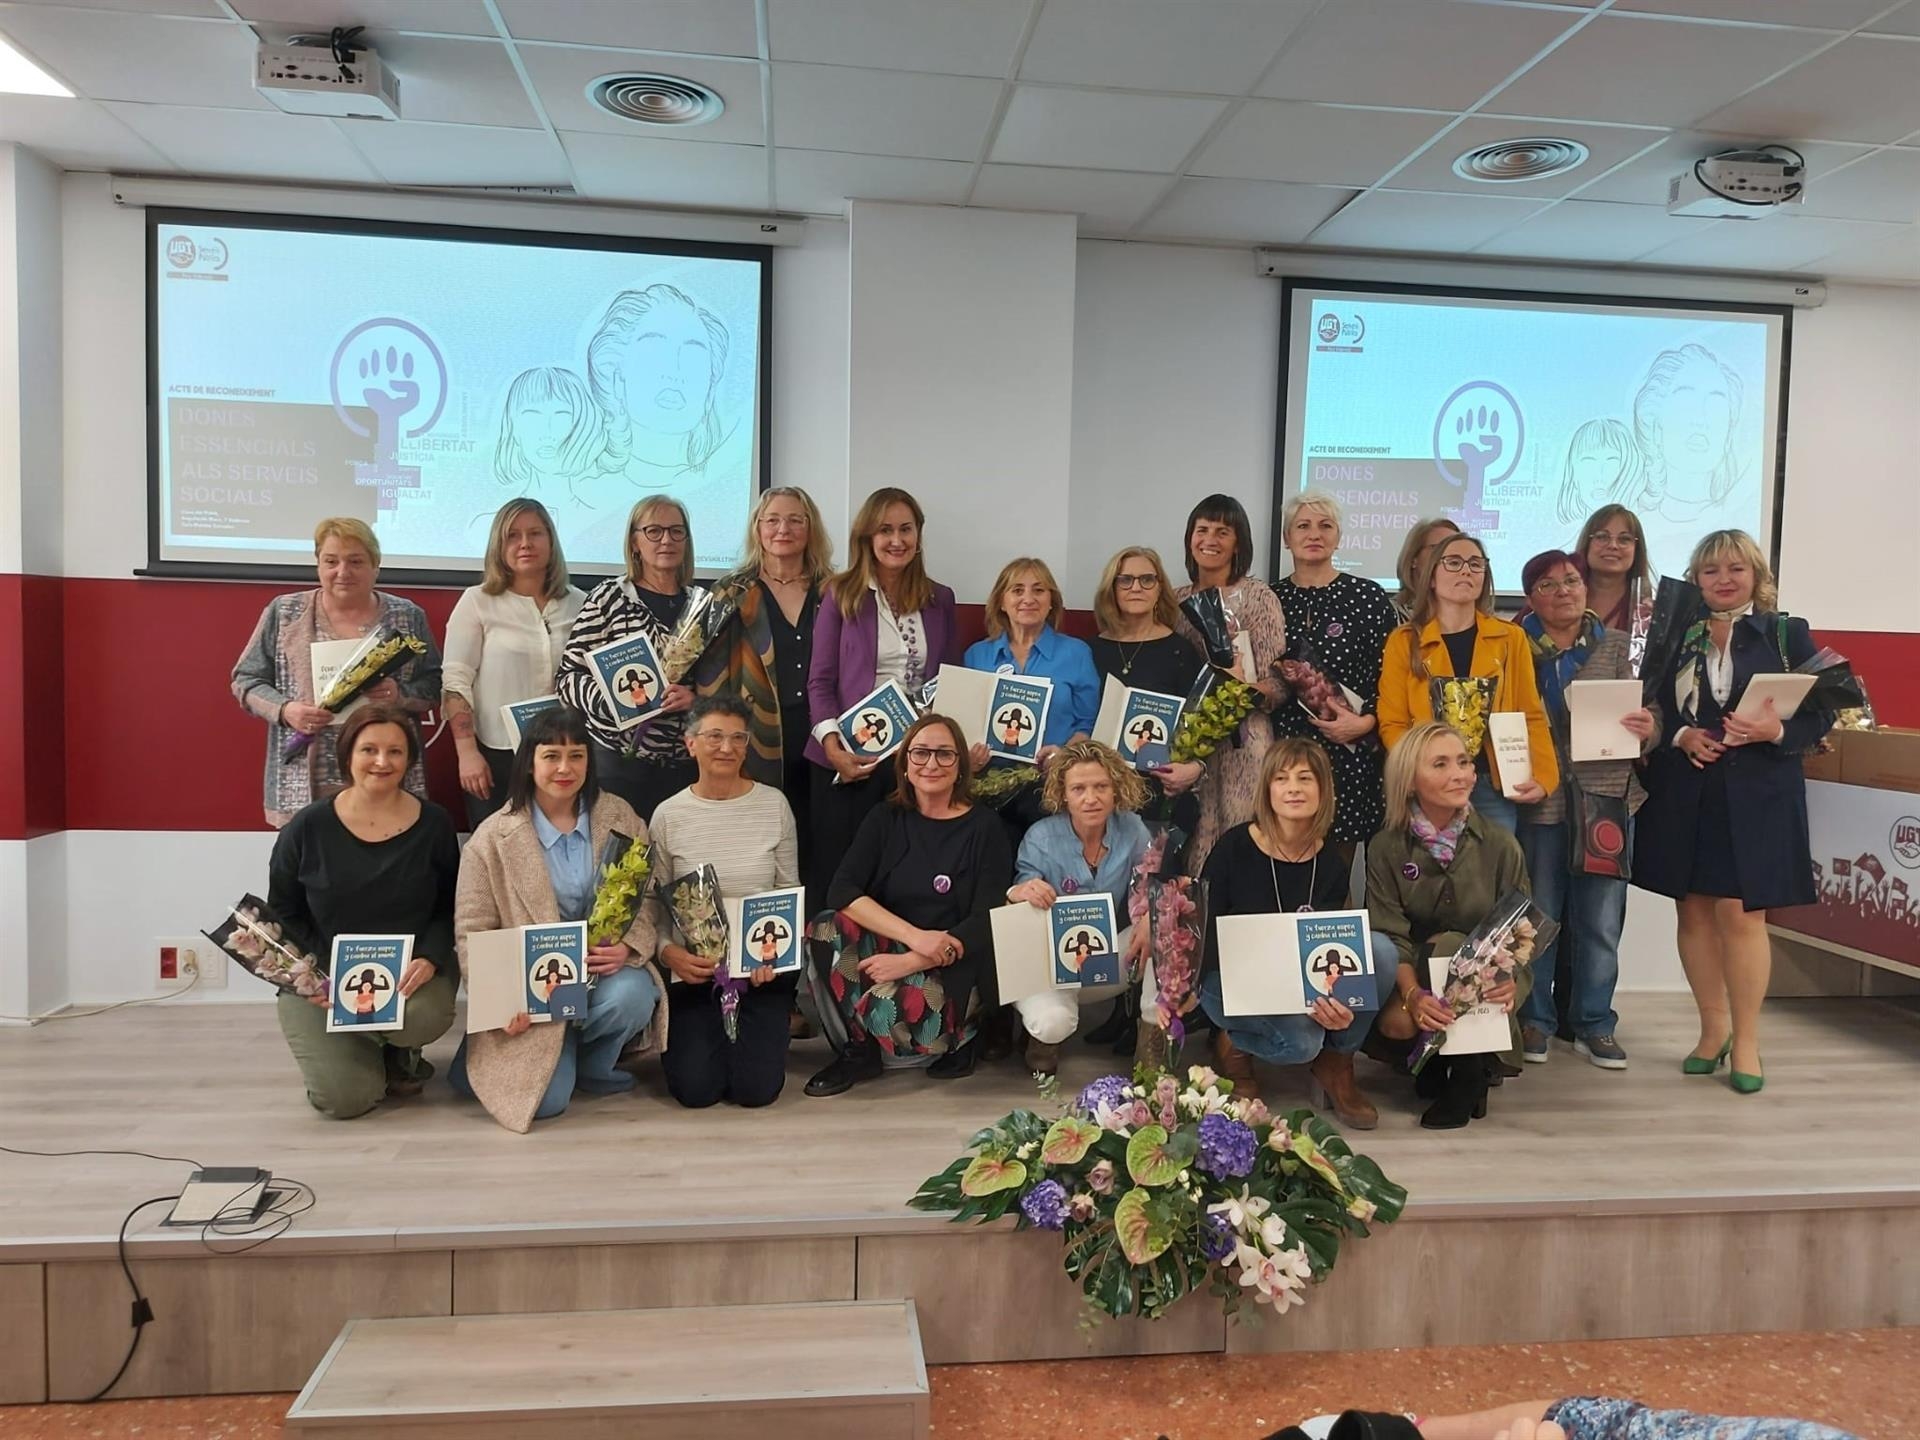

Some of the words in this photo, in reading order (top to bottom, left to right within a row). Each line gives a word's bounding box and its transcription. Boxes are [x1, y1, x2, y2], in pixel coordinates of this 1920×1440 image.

[169, 384, 191, 394] ACTE
[193, 385, 204, 395] DE
[206, 386, 276, 397] RECONEIXEMENT
[179, 407, 256, 428] DONES
[180, 434, 316, 457] ESSENCIALS
[401, 438, 476, 452] LLIBERTAT
[1337, 446, 1391, 454] RECONEIXEMENT
[181, 461, 222, 481] ALS
[228, 464, 318, 485] SERVEIS
[1315, 464, 1374, 481] DONES
[181, 486, 272, 506] SOCIALS
[382, 488, 432, 499] IGUALTAT
[1335, 489, 1419, 507] SENCIALS
[1484, 486, 1544, 497] LLIBERTAT
[1349, 513, 1419, 529] SERVEIS
